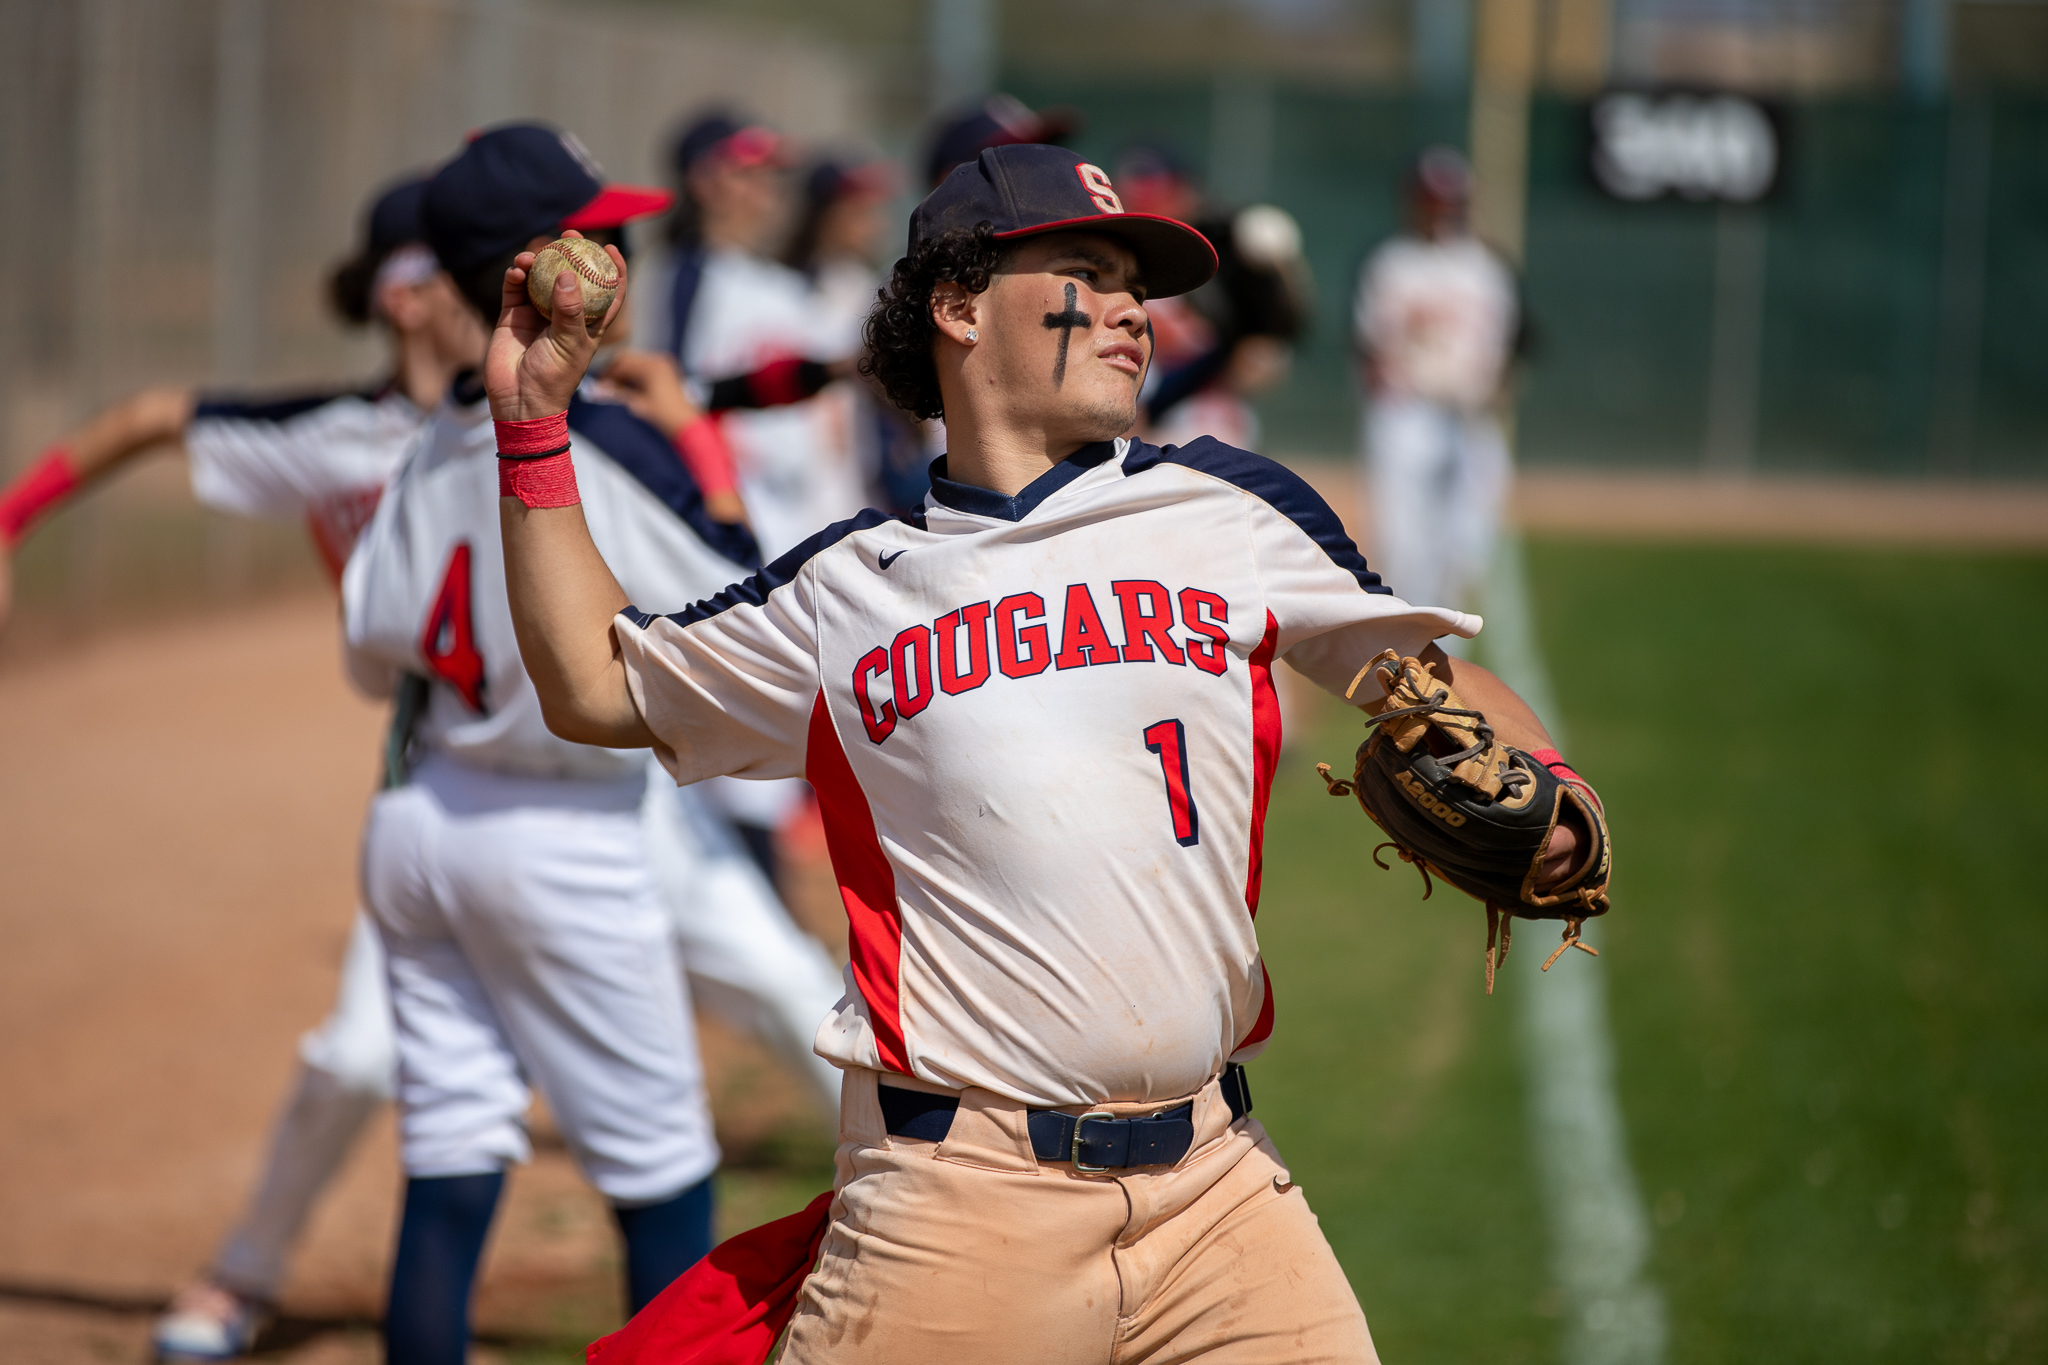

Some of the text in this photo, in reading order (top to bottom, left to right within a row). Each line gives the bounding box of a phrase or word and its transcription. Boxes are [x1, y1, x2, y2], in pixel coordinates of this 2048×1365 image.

[1075, 162, 1125, 214] S
[422, 542, 488, 714] 4
[852, 579, 1229, 745] COUGARS
[1143, 718, 1199, 847] 1
[1396, 771, 1466, 827] A2000
